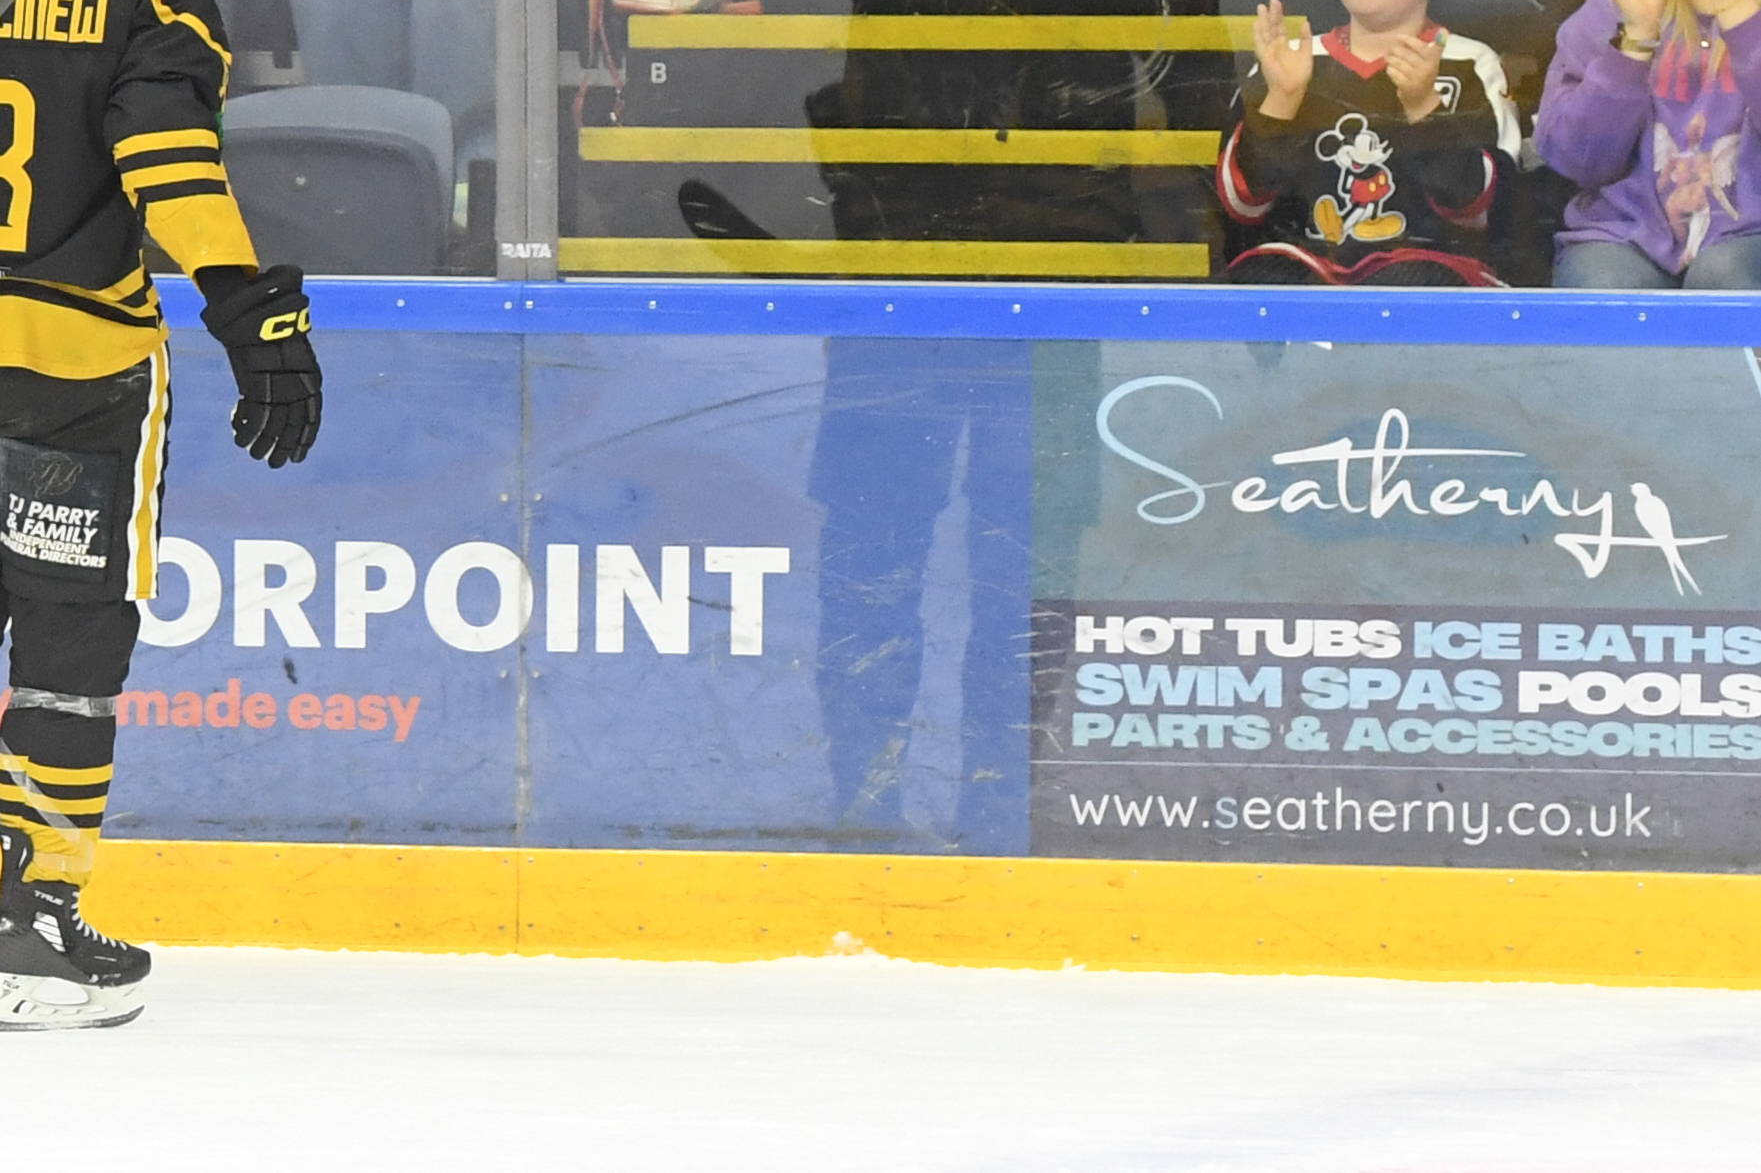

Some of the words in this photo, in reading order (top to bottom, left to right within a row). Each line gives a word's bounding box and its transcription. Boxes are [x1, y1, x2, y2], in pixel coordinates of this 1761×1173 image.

[650, 61, 668, 85] B
[500, 242, 553, 259] RAITA
[259, 306, 311, 342] CC
[1096, 375, 1728, 580] Seatherny
[8, 493, 25, 515] TJ
[28, 500, 100, 527] PARRY
[6, 512, 19, 531] &
[22, 518, 99, 545] FAMILY
[9, 529, 91, 556] INDEPENDENT
[39, 547, 108, 569] DIRECTORS
[1074, 616, 1214, 656] HOT
[1225, 618, 1402, 659] TUBS
[1413, 621, 1522, 662] ICE
[1538, 623, 1761, 665] BATHS
[1075, 664, 1283, 708] SWIM
[1300, 667, 1505, 713] SPAS
[1518, 671, 1761, 718] POOLS
[116, 679, 278, 729] made
[288, 691, 422, 742] easy
[1071, 712, 1272, 752] PARTS
[1285, 715, 1331, 753] &
[1342, 717, 1761, 761] ACCESSORIES
[1069, 787, 1653, 847] www.seatherny.co.uk
[33, 889, 65, 906] TRUE
